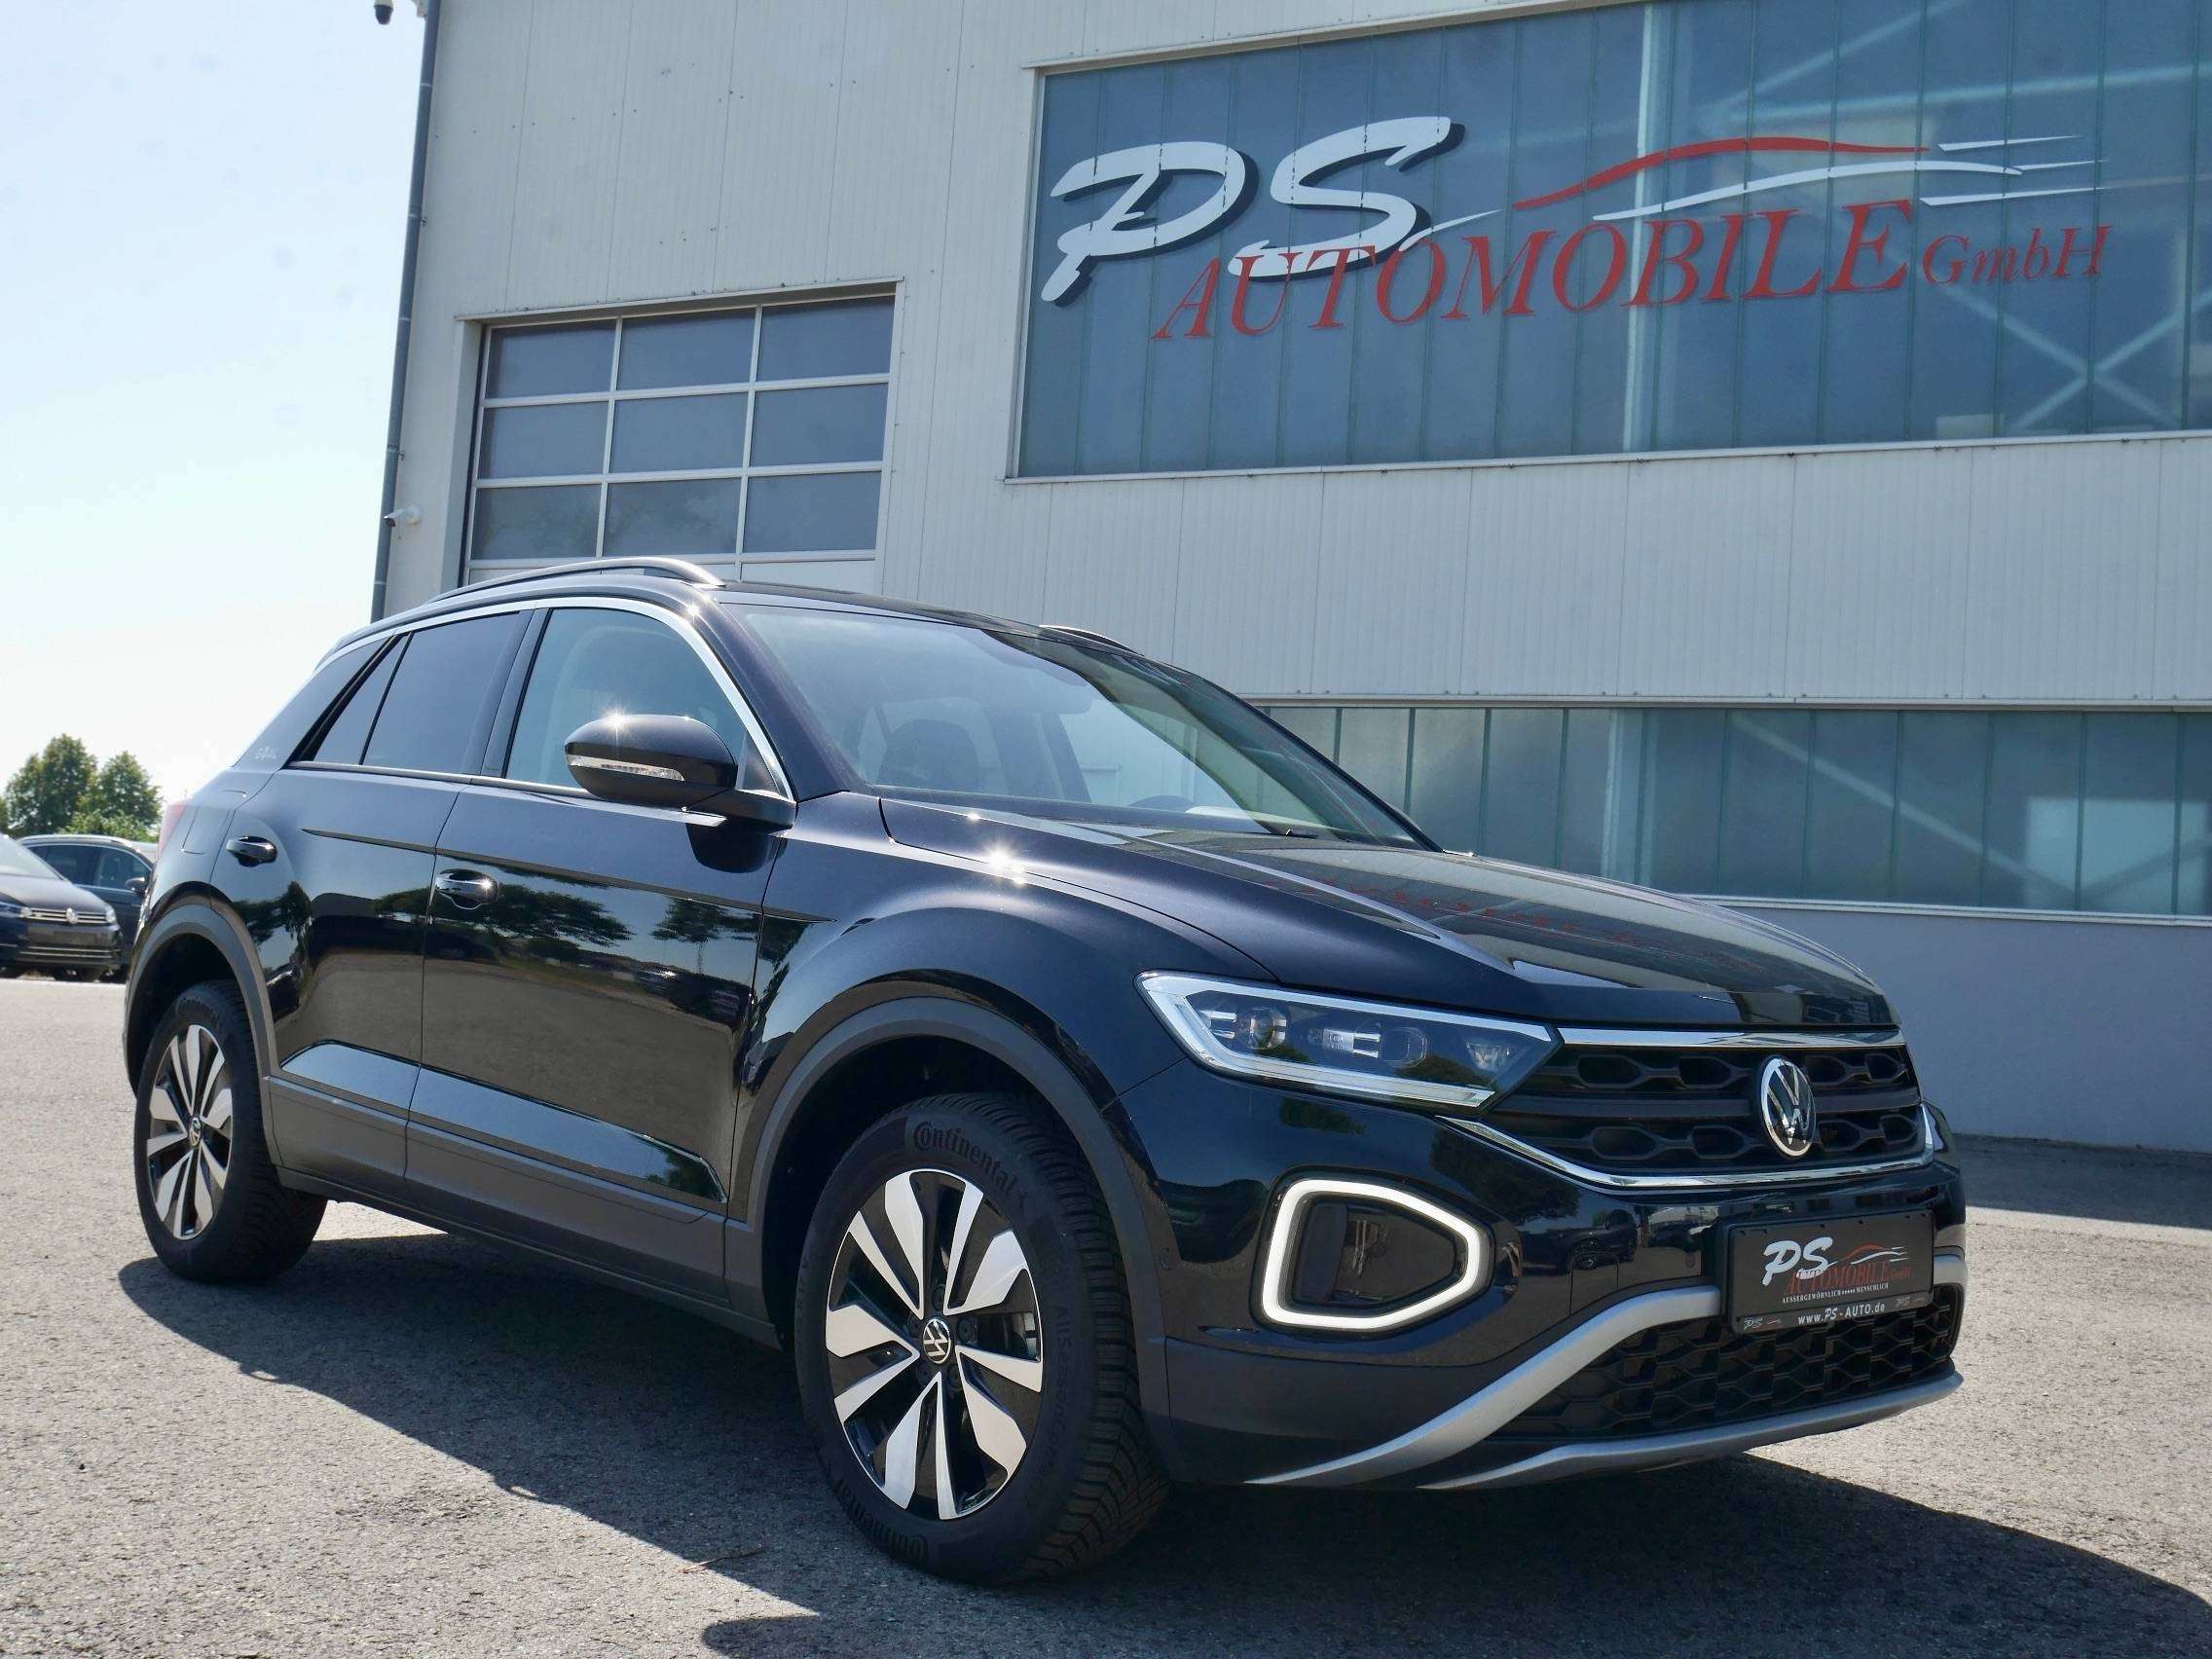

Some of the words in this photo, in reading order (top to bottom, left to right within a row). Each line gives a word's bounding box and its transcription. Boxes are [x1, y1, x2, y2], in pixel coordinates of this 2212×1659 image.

[1042, 116, 1464, 306] PS
[1151, 200, 1912, 341] AUTOMOBILE
[1922, 225, 2114, 286] GmbH
[1762, 1236, 1834, 1286] PS
